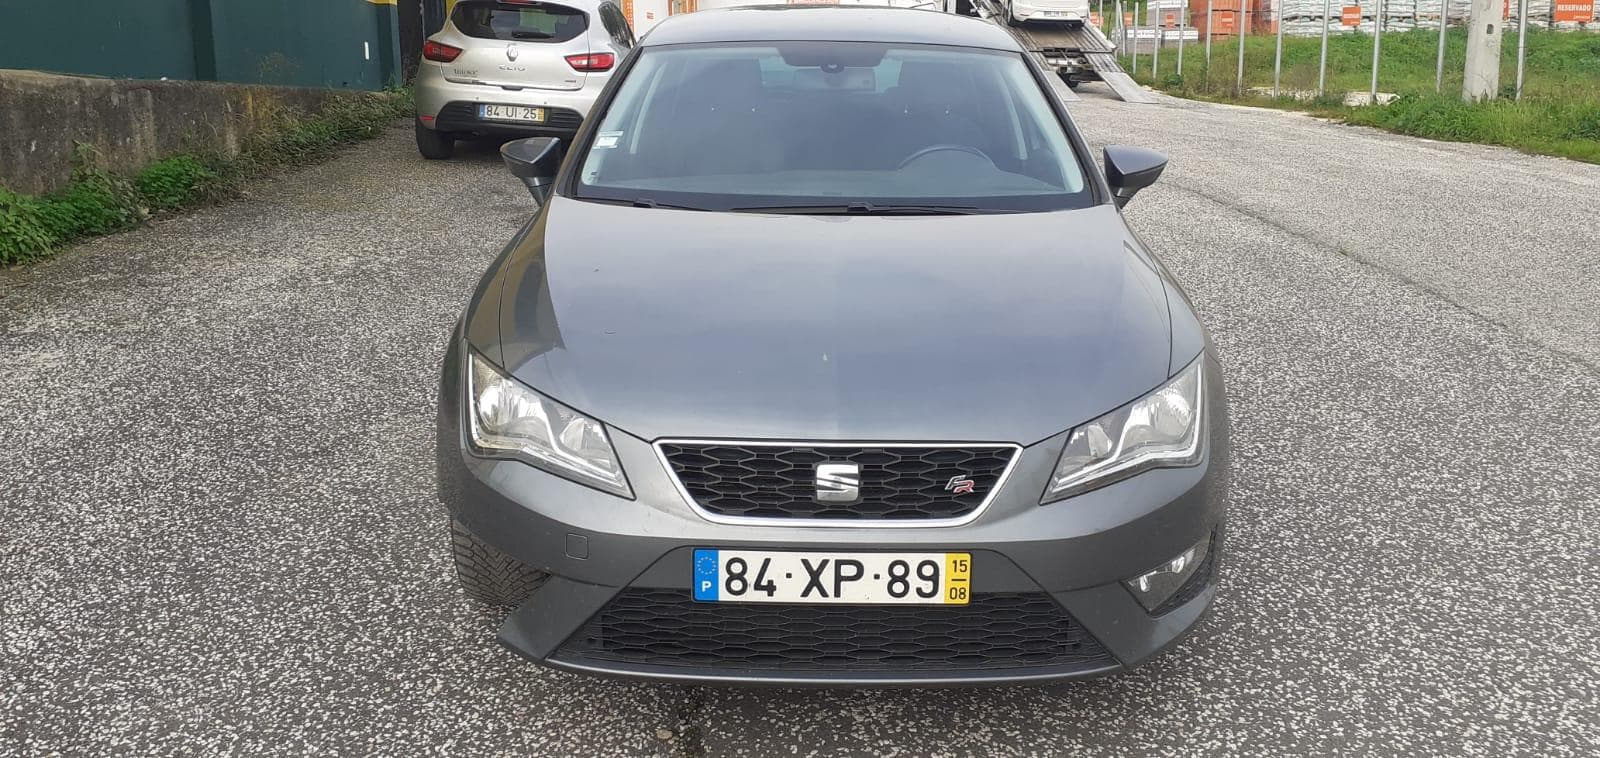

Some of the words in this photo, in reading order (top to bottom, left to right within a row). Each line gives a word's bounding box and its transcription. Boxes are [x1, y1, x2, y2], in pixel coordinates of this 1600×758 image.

[1557, 4, 1592, 12] RESERVADO
[944, 474, 975, 493] FR
[952, 559, 968, 573] 15
[701, 581, 712, 592] P
[949, 587, 967, 600] 08
